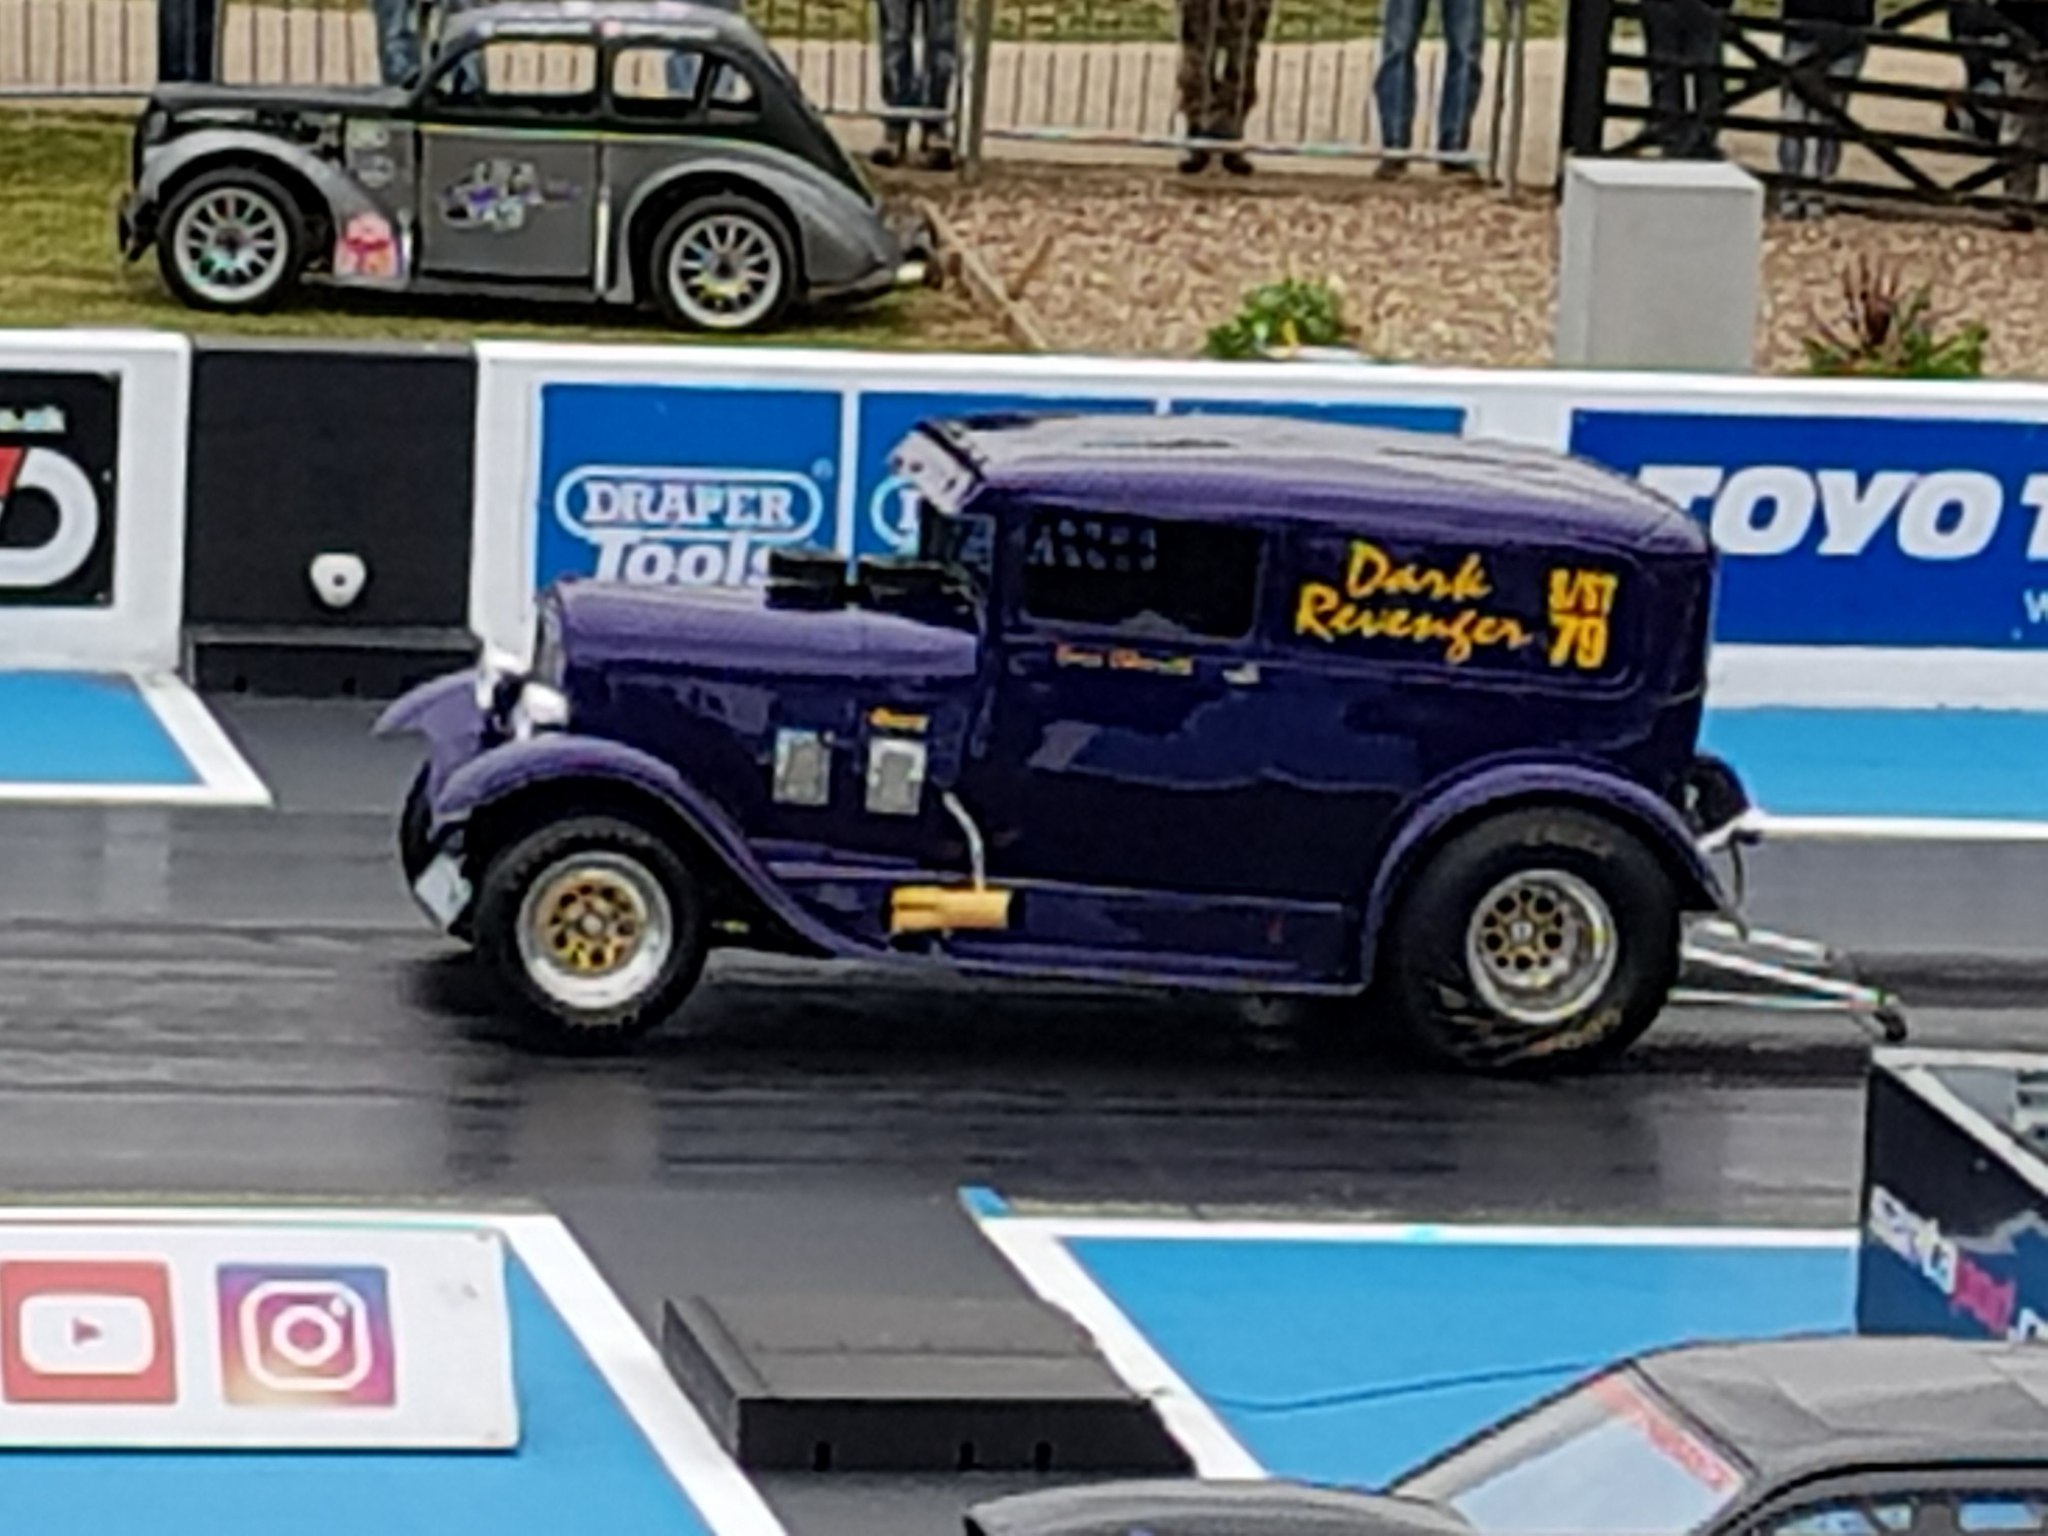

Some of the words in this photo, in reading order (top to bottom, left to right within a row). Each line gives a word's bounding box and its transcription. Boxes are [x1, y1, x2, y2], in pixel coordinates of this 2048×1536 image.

[583, 480, 795, 527] DRAPER
[1637, 465, 2004, 560] TOYO
[1347, 540, 1493, 601] Dark
[1296, 581, 1535, 665] Revenger
